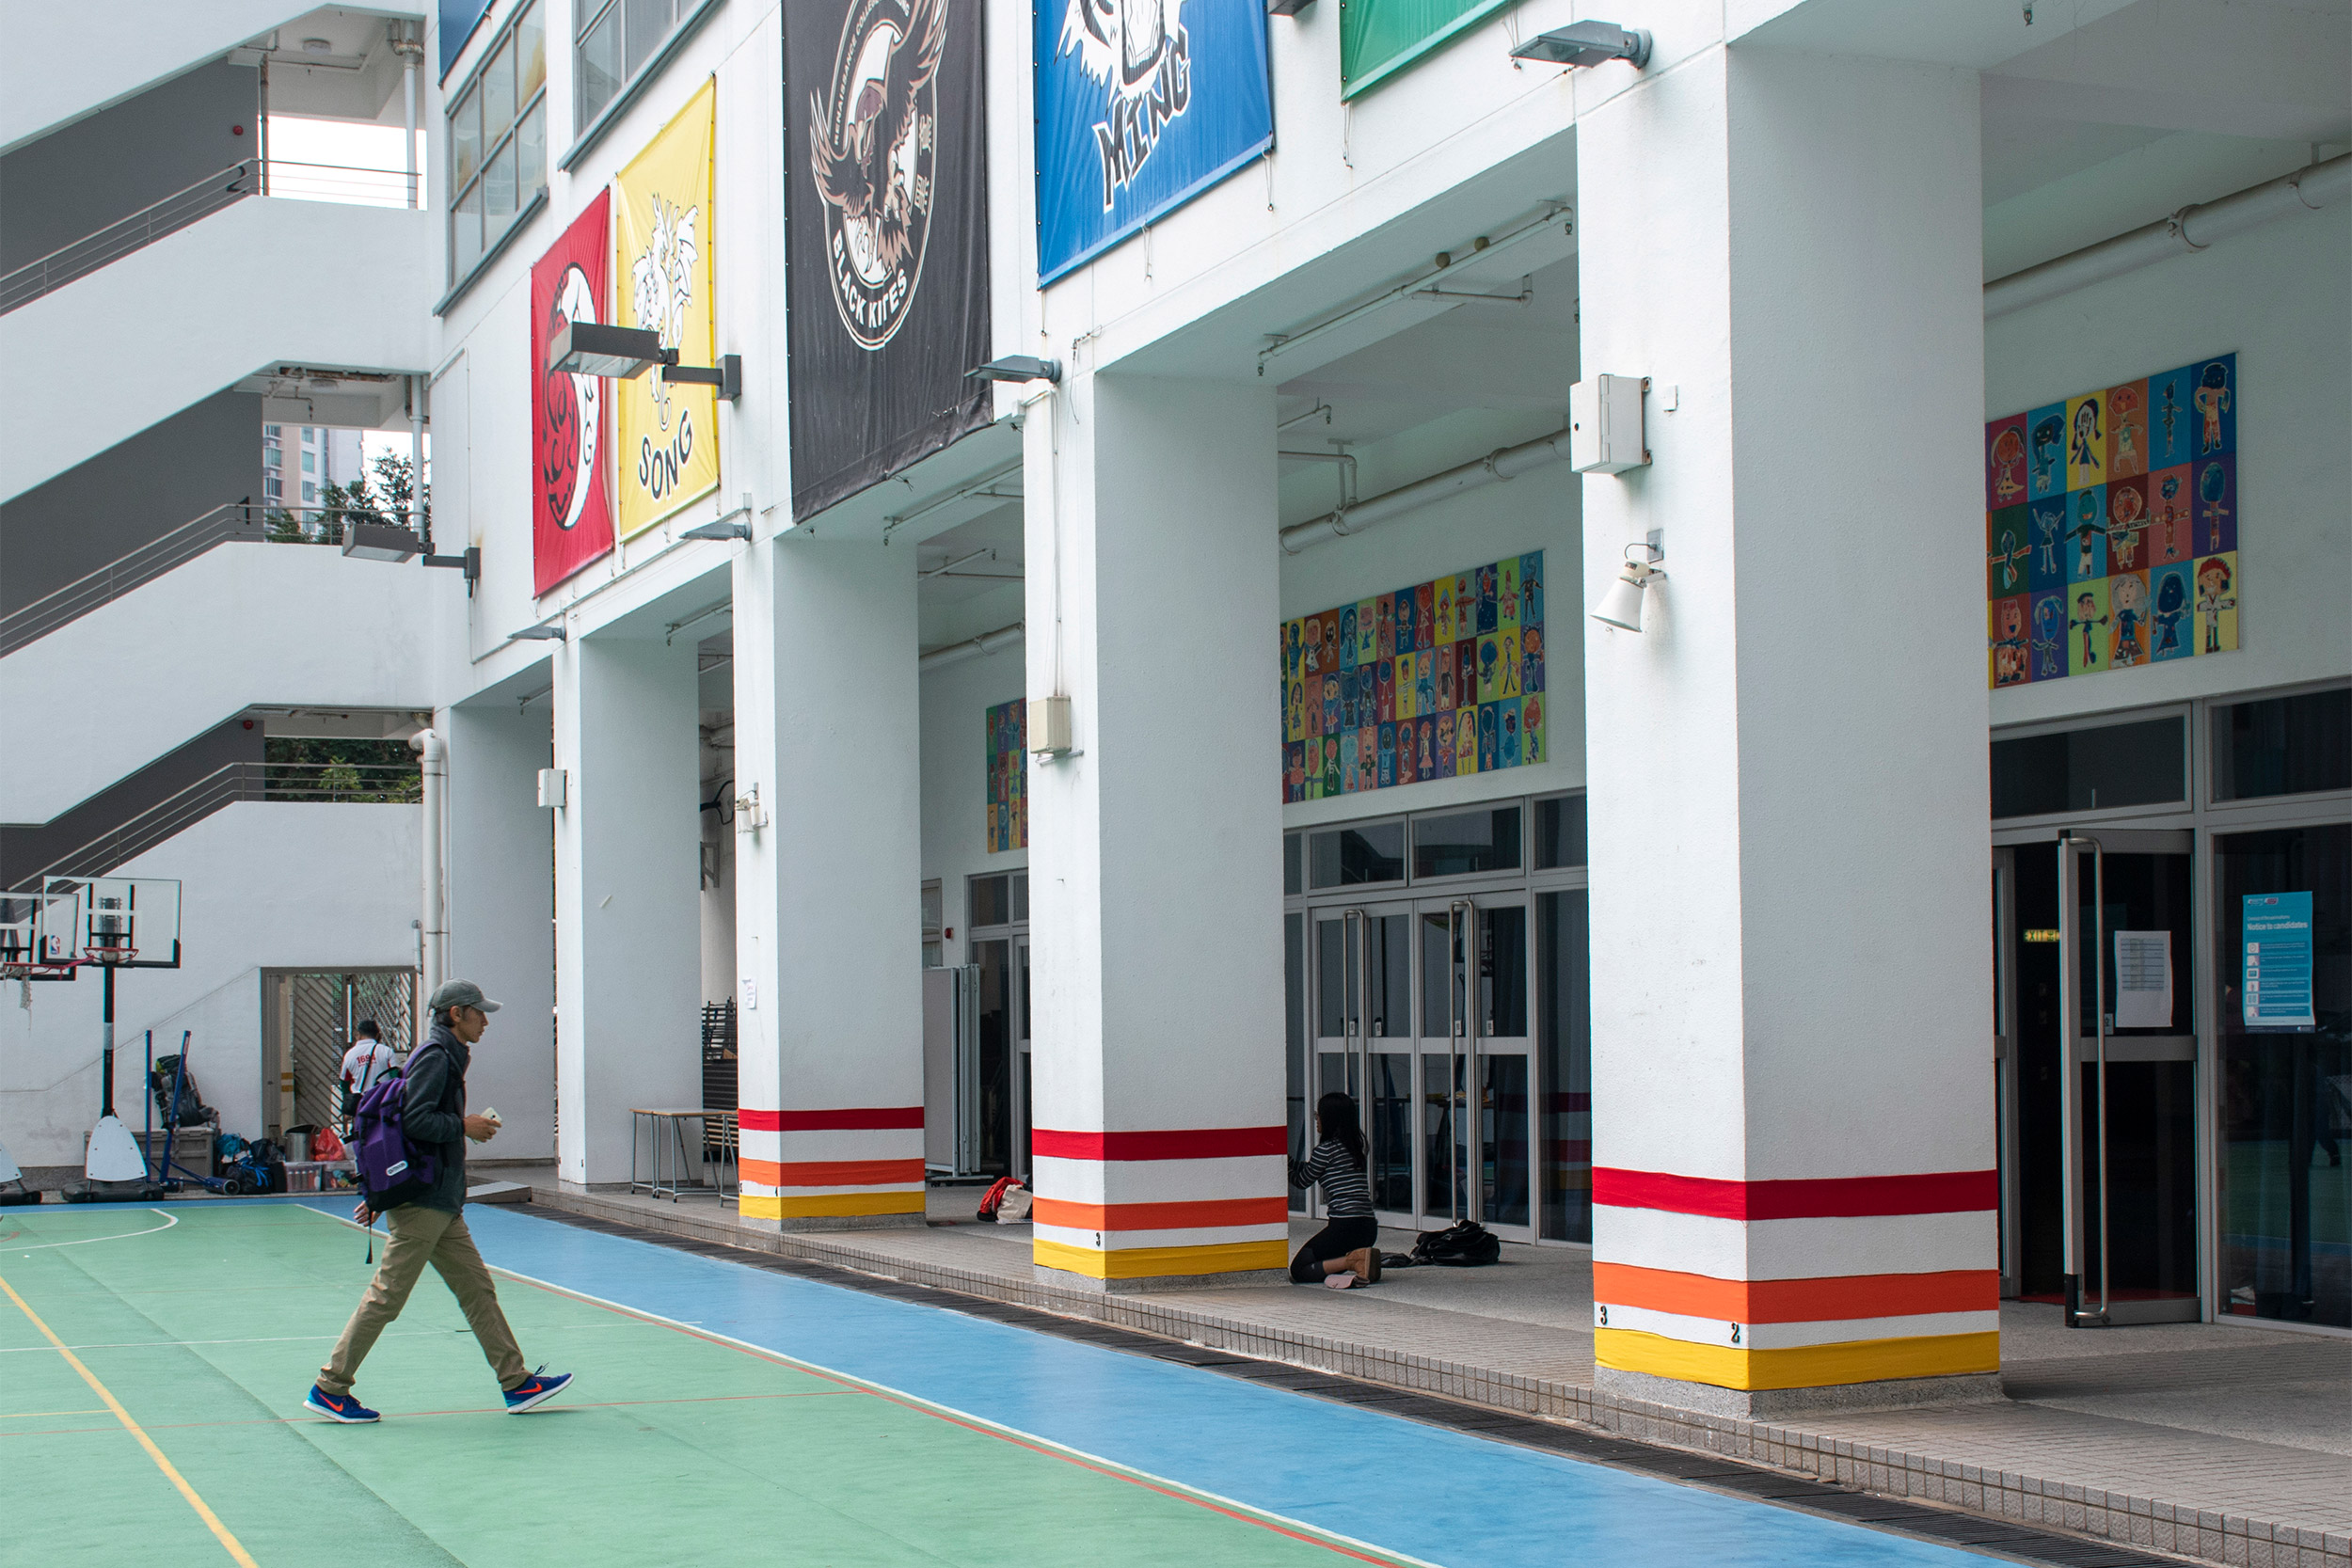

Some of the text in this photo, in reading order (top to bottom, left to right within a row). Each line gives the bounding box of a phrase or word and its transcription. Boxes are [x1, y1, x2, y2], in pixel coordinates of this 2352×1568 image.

[1092, 23, 1191, 214] MING
[226, 164, 246, 194] 2
[833, 229, 907, 328] BLACK KITES
[639, 408, 693, 501] SONG
[238, 496, 250, 525] 1
[2024, 929, 2044, 942] EXIT
[2274, 922, 2309, 930] candidates
[1095, 1232, 1101, 1246] 3
[1599, 1305, 1607, 1325] 3
[1731, 1323, 1740, 1343] 2
